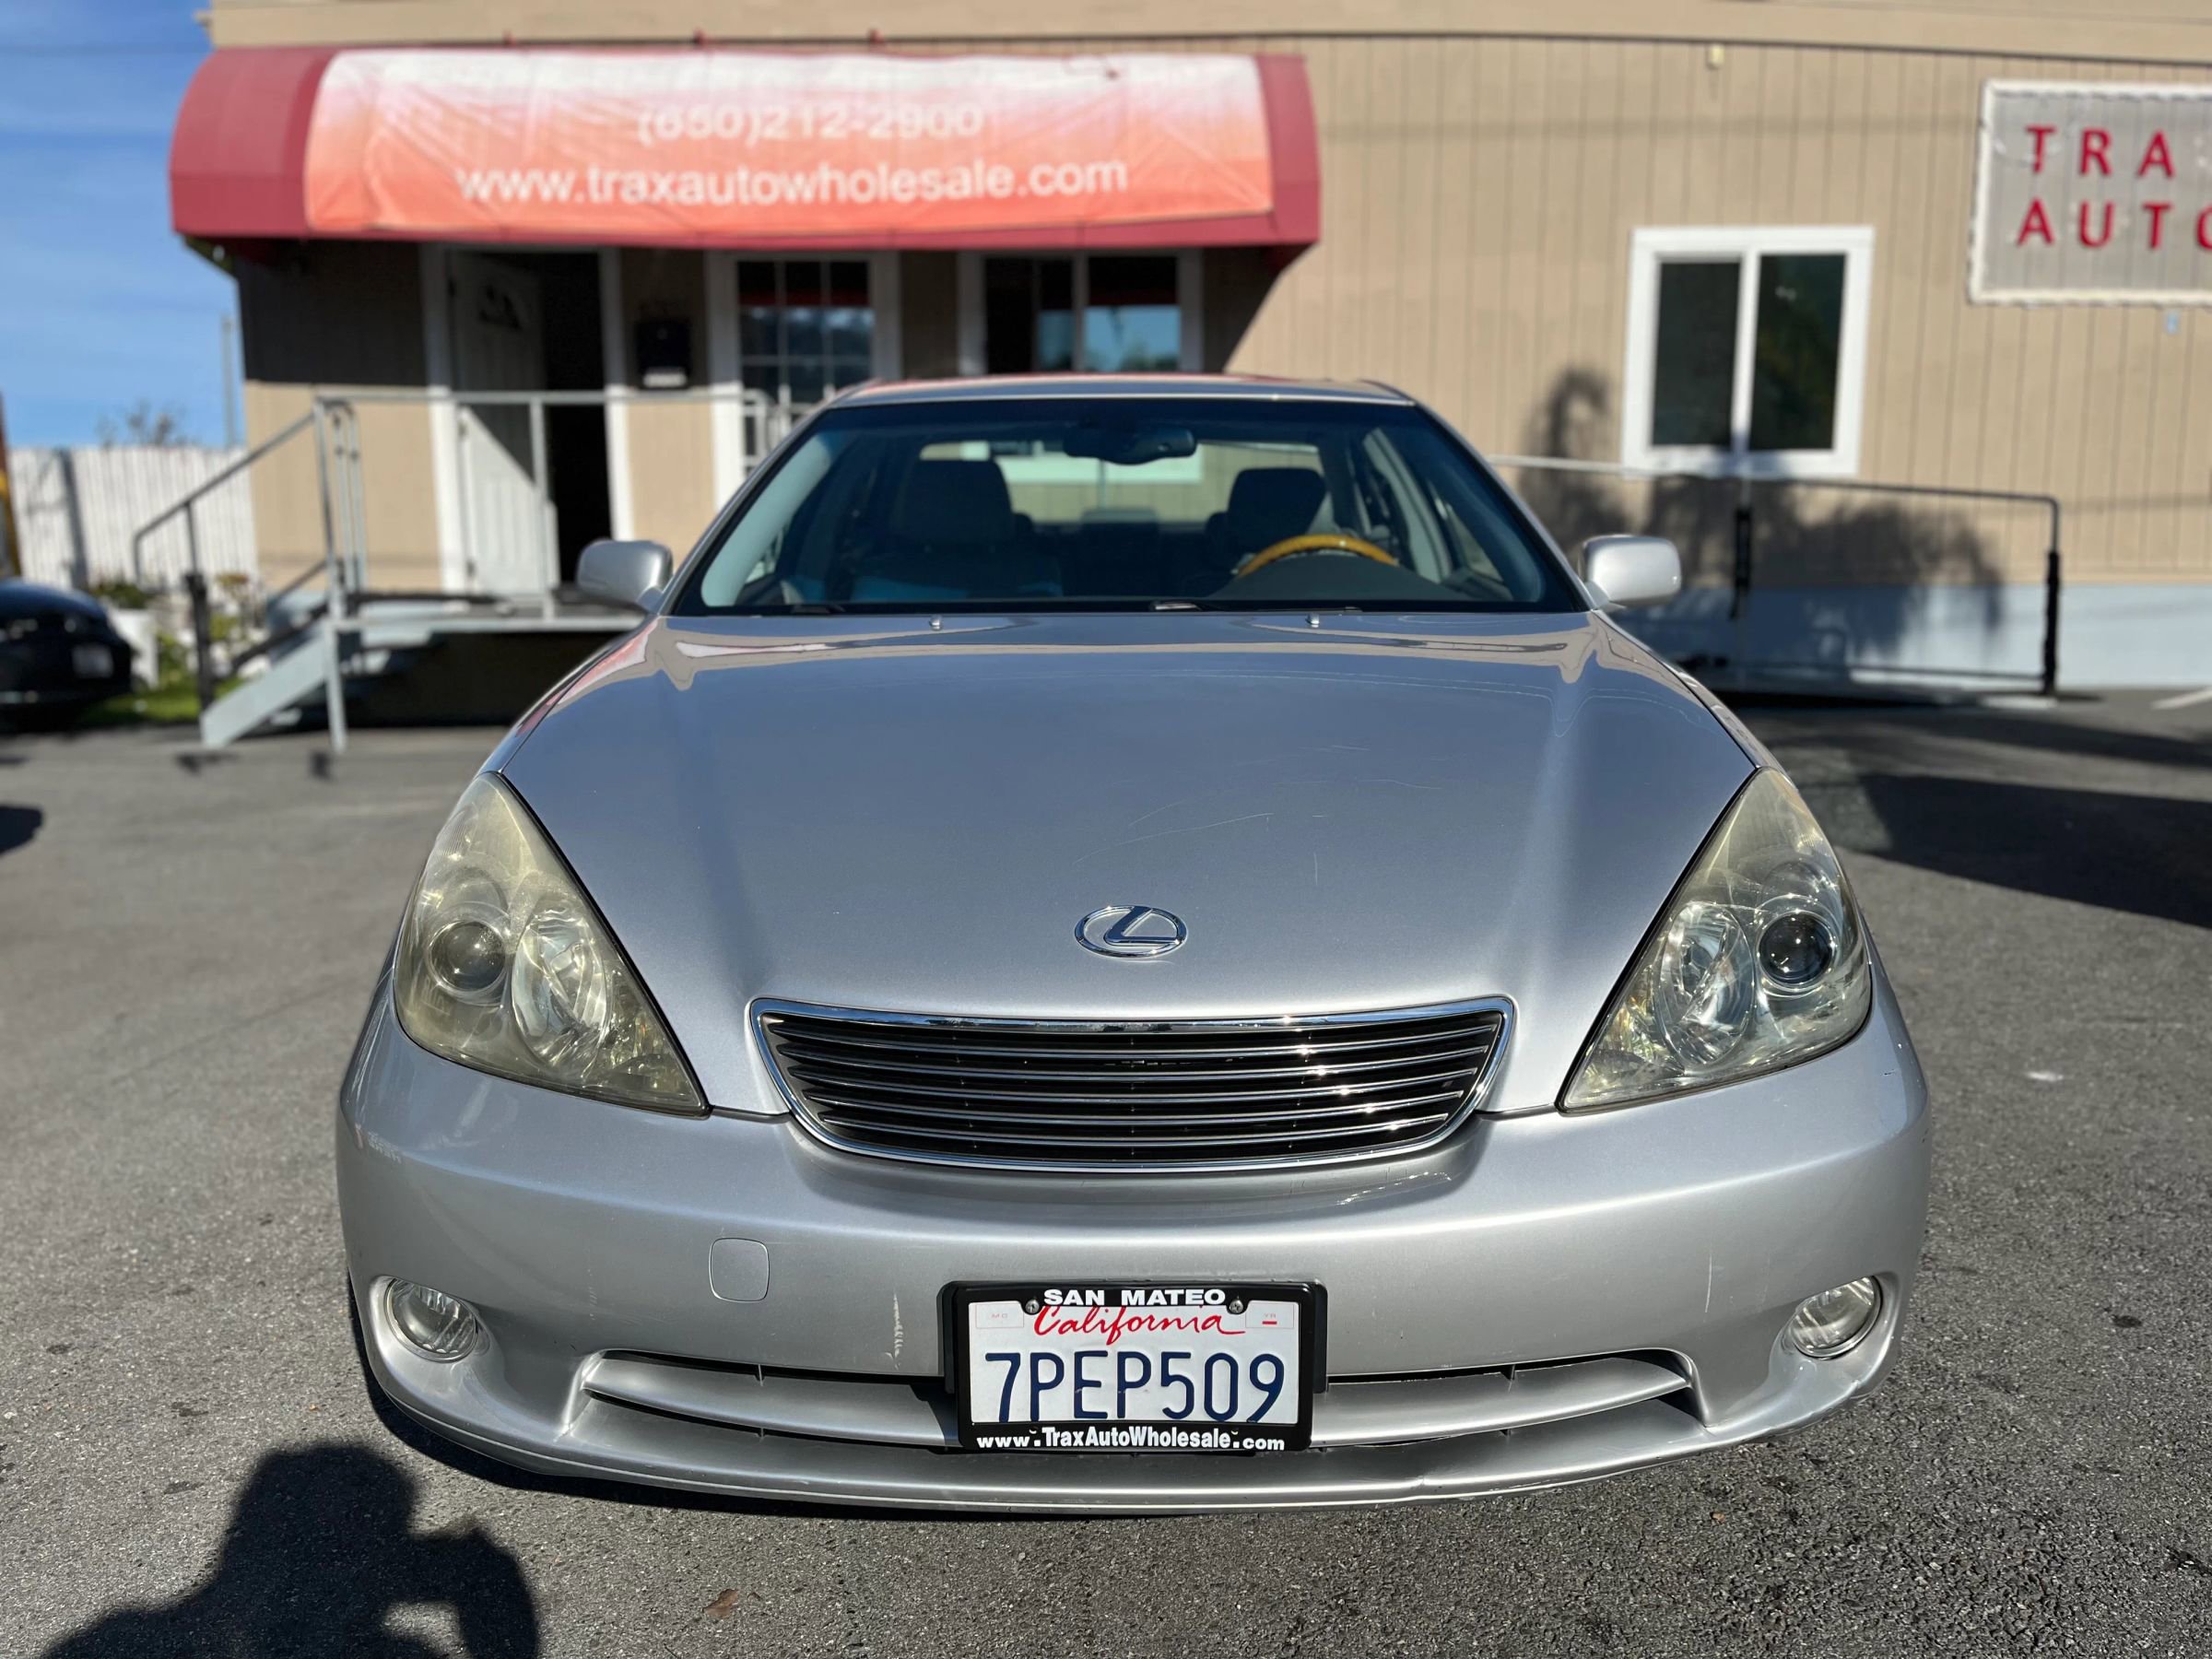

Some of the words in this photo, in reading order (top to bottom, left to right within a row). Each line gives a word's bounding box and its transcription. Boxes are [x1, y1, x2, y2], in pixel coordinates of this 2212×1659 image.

[2024, 124, 2175, 178] TRA
[456, 158, 1128, 206] www.traxautowholesale.com
[1044, 1288, 1105, 1306] SAN
[1122, 1288, 1226, 1306] MATEO
[1033, 1305, 1245, 1345] California
[985, 1350, 1286, 1423] 7PEP509
[977, 1426, 1286, 1452] www.TraxAutoWholesale.com
